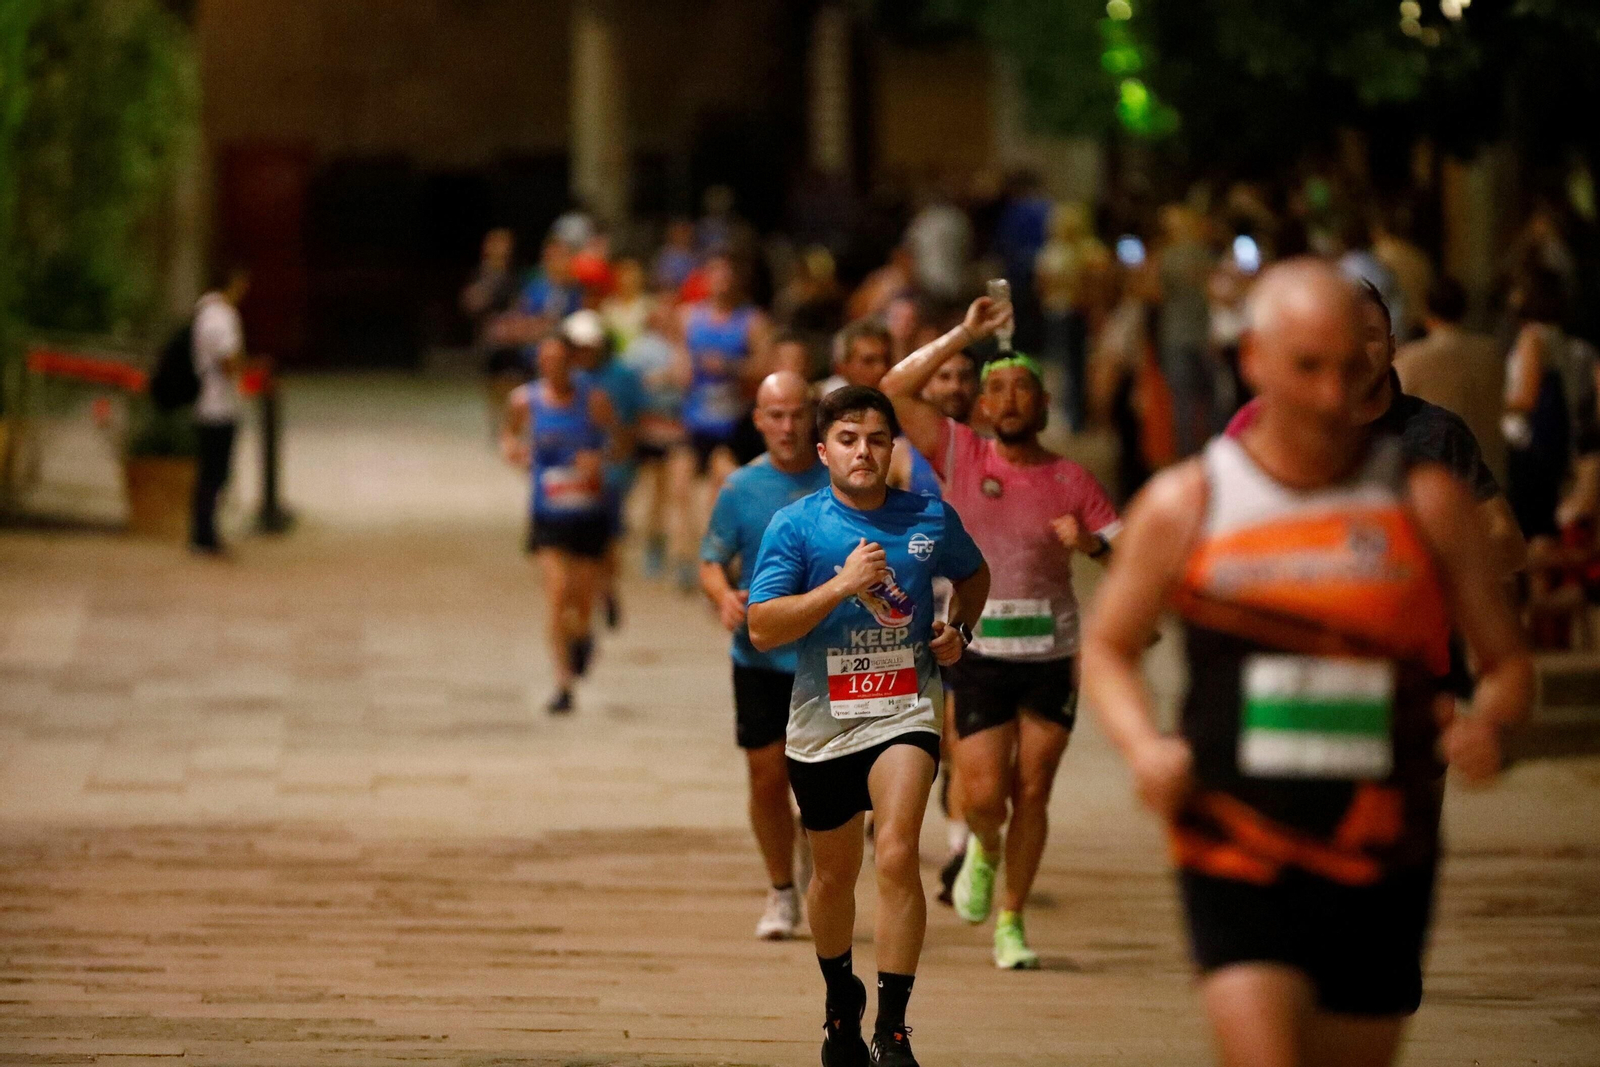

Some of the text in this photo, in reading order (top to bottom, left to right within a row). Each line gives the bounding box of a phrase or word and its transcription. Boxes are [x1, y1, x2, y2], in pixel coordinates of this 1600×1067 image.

[851, 627, 908, 647] KEEP
[853, 658, 870, 671] 20
[848, 671, 898, 693] 1677
